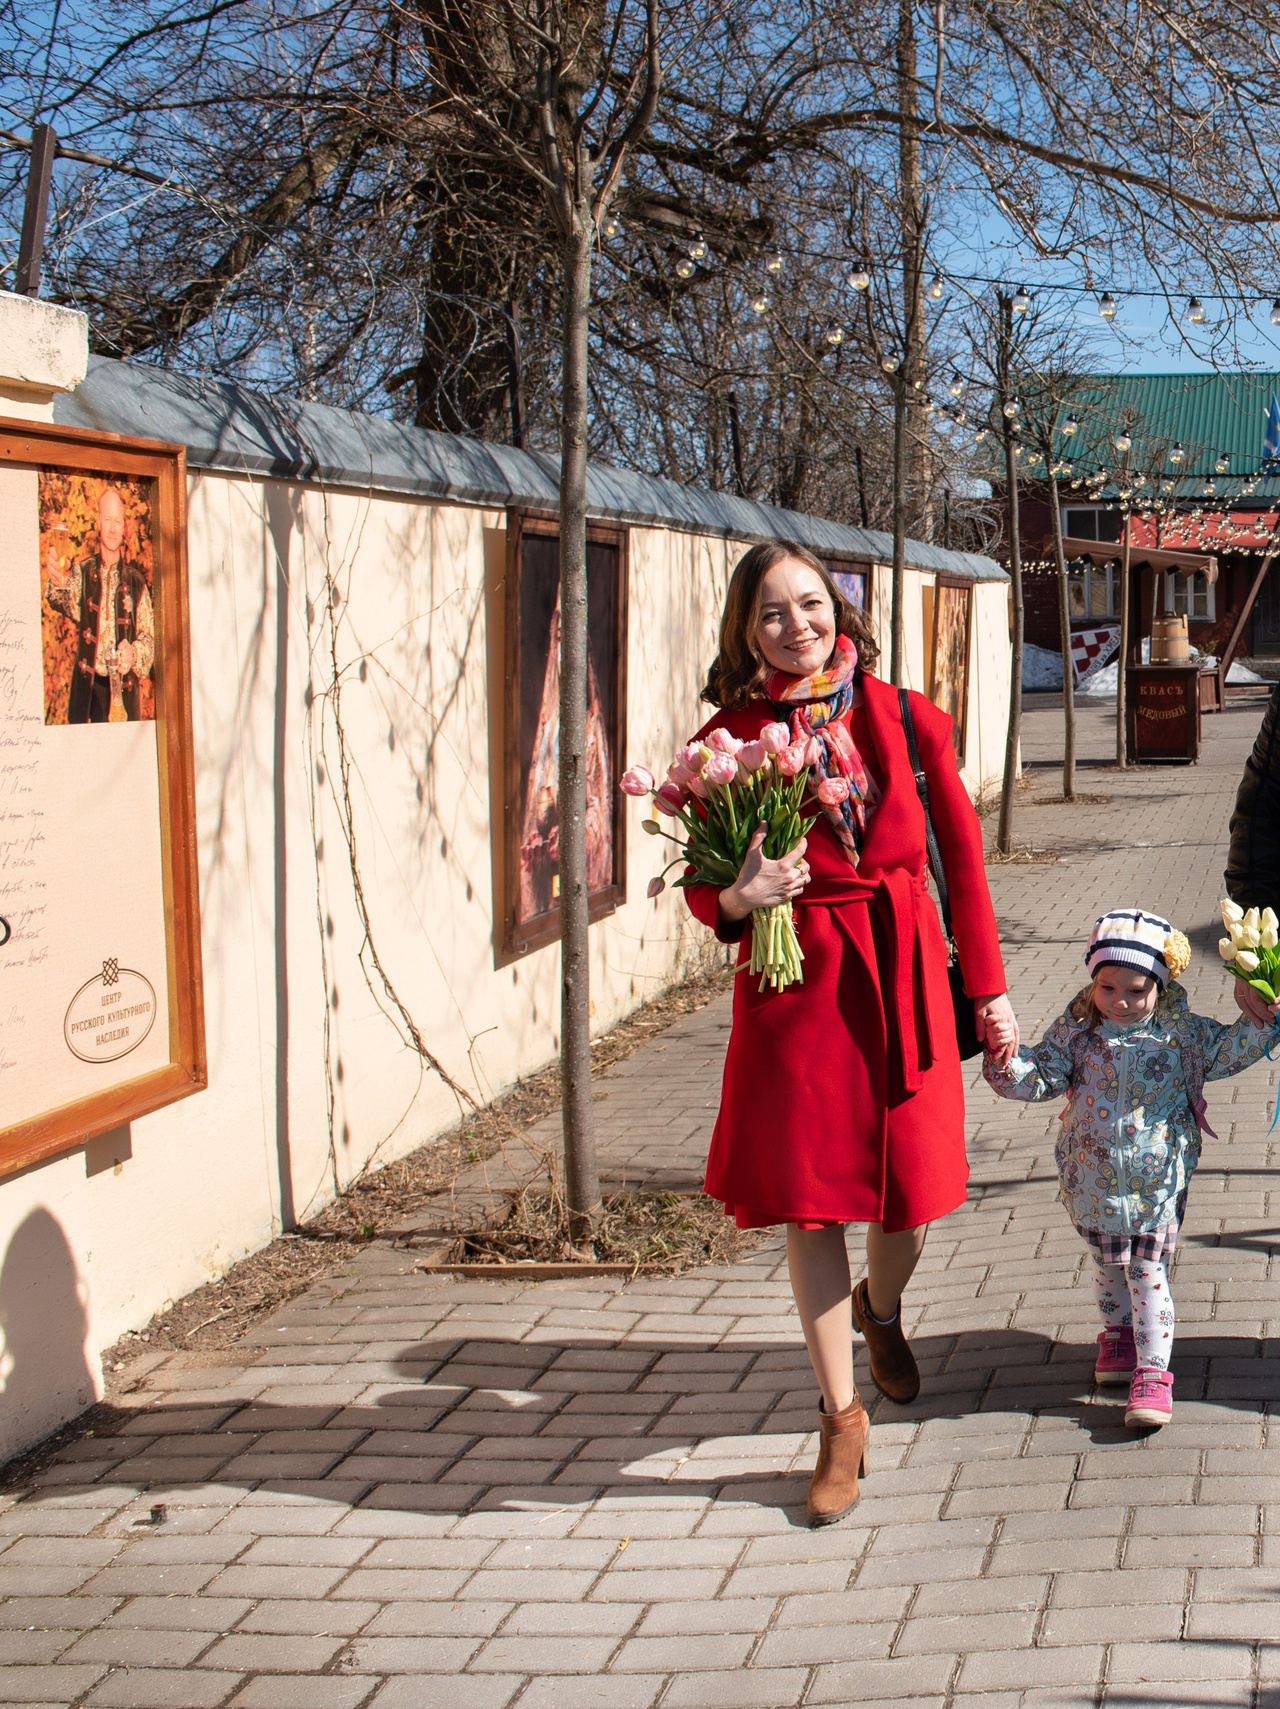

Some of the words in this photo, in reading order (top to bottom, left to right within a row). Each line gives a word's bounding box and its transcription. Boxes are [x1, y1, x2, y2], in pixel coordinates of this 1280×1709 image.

[1140, 686, 1184, 696] КВАСЪ
[1137, 704, 1187, 720] МЕДОВЫЙ
[101, 992, 121, 1007] ЦЕНТР
[71, 1015, 105, 1034] РУССКОГО
[107, 1002, 151, 1024] КУЛЬТУРНОГО
[96, 1026, 130, 1046] НАСЛЕДИЯ
